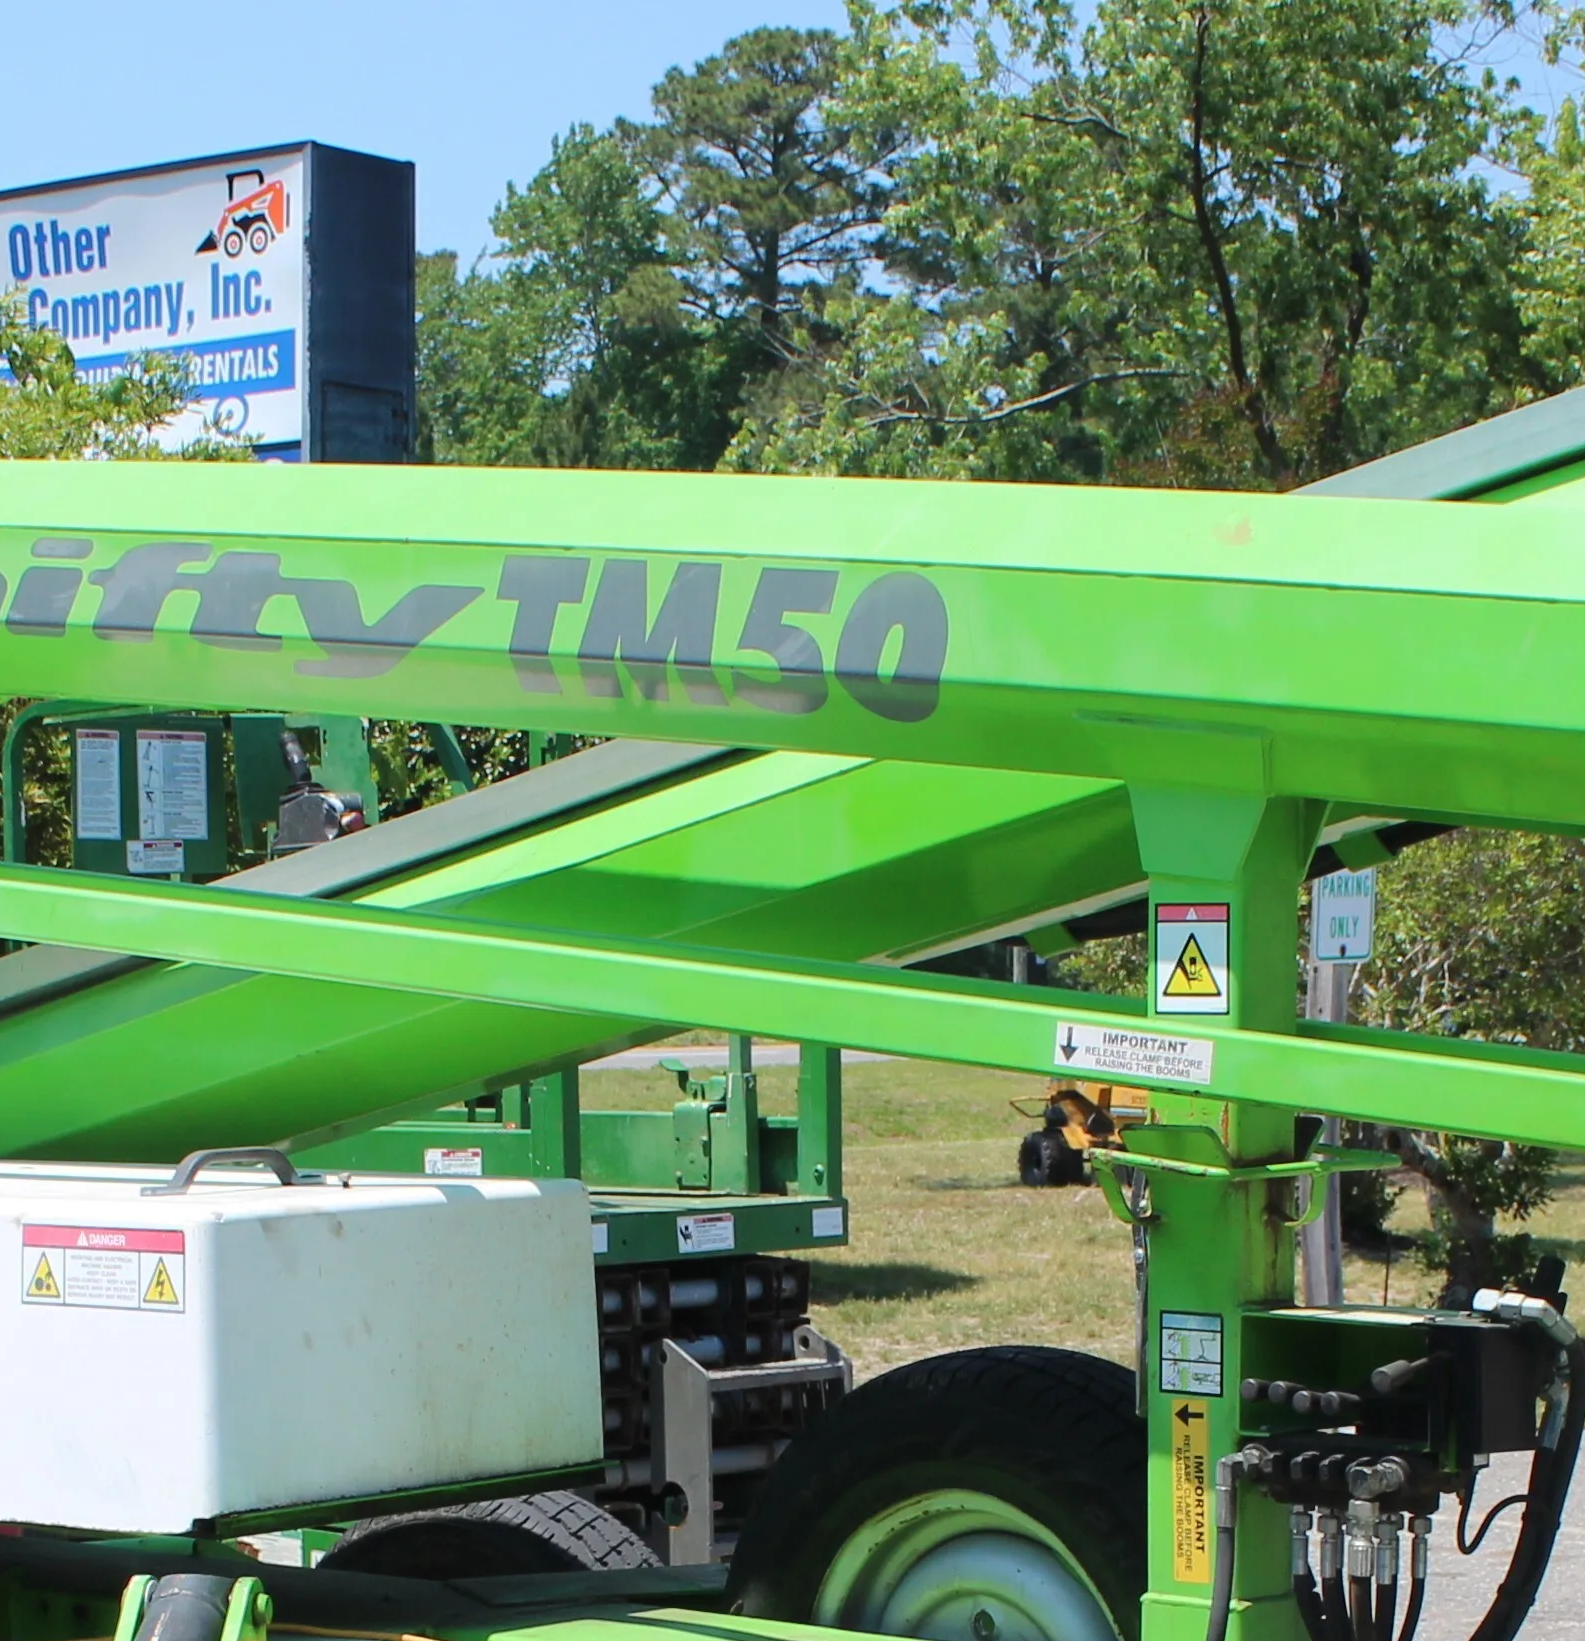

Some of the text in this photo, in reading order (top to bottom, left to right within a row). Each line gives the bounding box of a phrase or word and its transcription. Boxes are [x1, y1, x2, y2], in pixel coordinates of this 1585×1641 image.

[8, 219, 111, 281] Other
[28, 281, 195, 345] Company,
[210, 261, 272, 320] Inc.
[191, 344, 279, 386] RENTALS
[496, 553, 950, 723] TM50
[1321, 876, 1371, 897] PARKING
[1329, 916, 1360, 939] ONLY
[1084, 1045, 1203, 1070] RELEASE CLAMP BEFORE
[1102, 1031, 1188, 1054] IMPORTANT
[1094, 1057, 1191, 1079] RAISING THE BOOMS
[89, 1233, 126, 1247] DANGER
[1175, 1447, 1184, 1558] RAISING THE BOOMS
[1183, 1434, 1193, 1572] RELEASE CLAMP BEFORE
[1193, 1455, 1205, 1554] IMPORTANT
